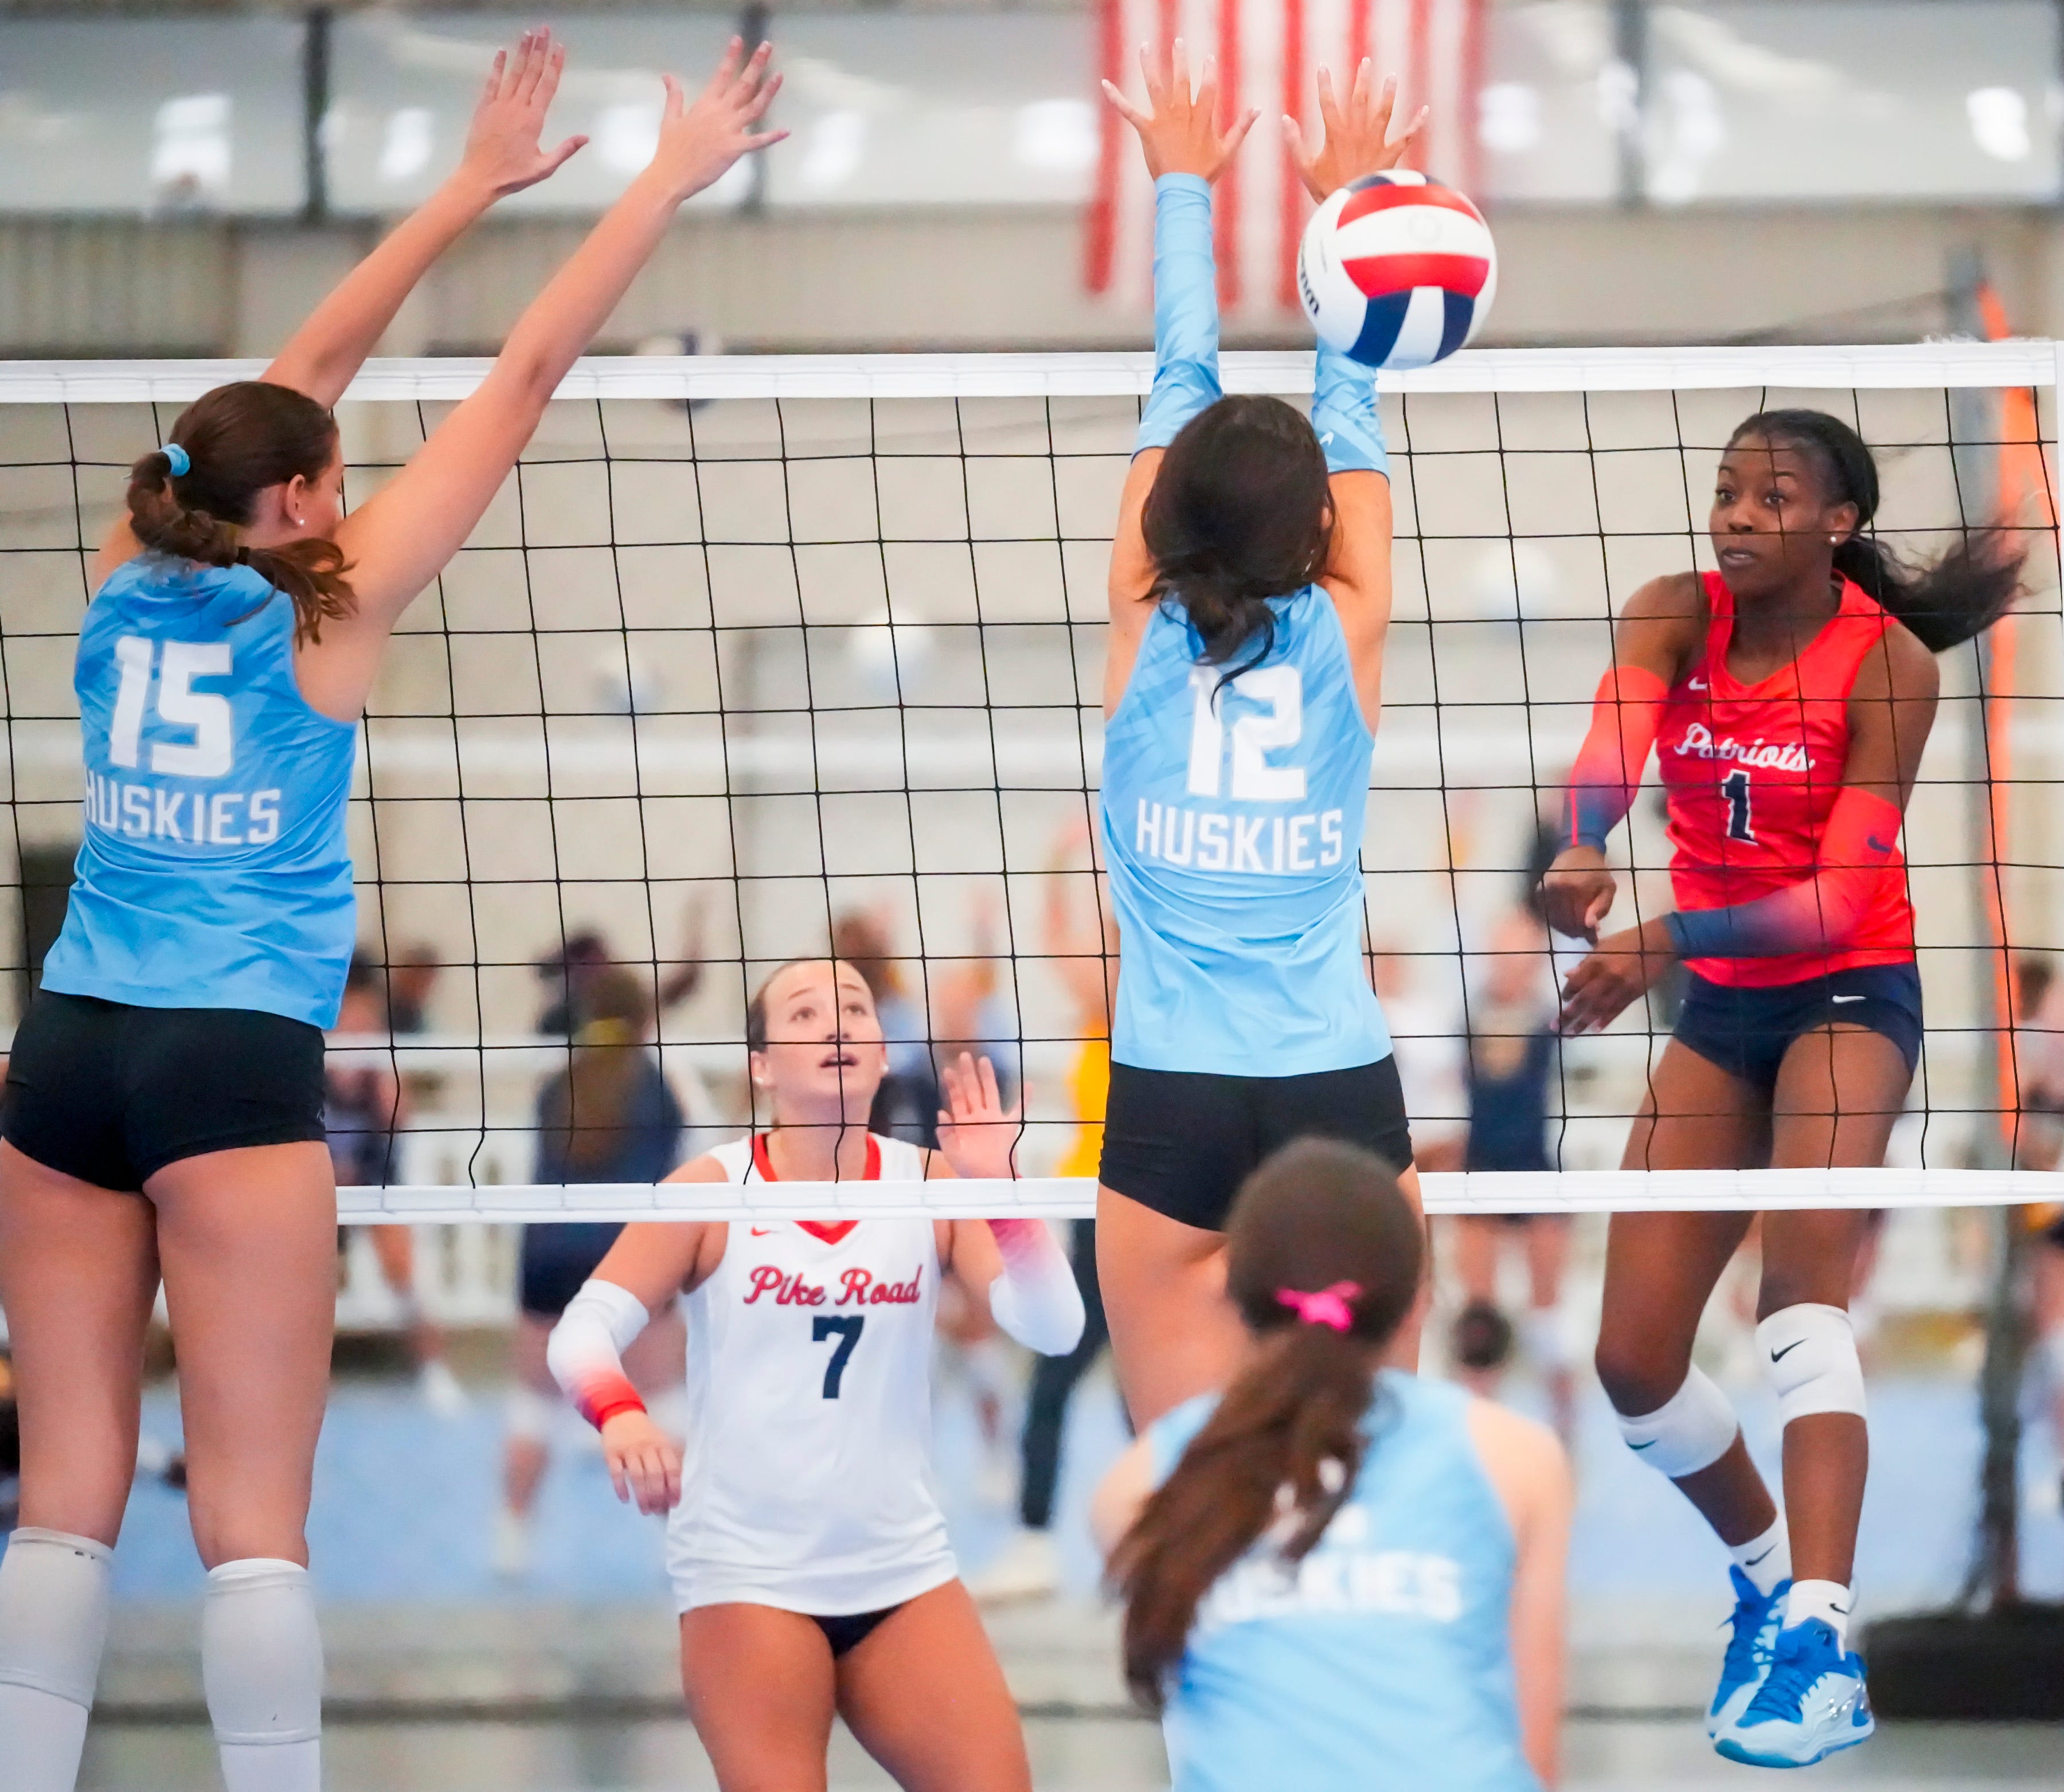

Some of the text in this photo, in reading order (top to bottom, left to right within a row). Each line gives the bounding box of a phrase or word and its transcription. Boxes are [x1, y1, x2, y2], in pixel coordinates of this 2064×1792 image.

[110, 635, 232, 777] 15
[1186, 665, 1307, 800] 12
[1674, 722, 1816, 772] Patriots
[85, 768, 281, 845] HUSKIES
[1136, 798, 1343, 872] HUSKIES
[1721, 768, 1759, 846] 1
[743, 1263, 923, 1306] Pike Road
[812, 1314, 865, 1399] 7
